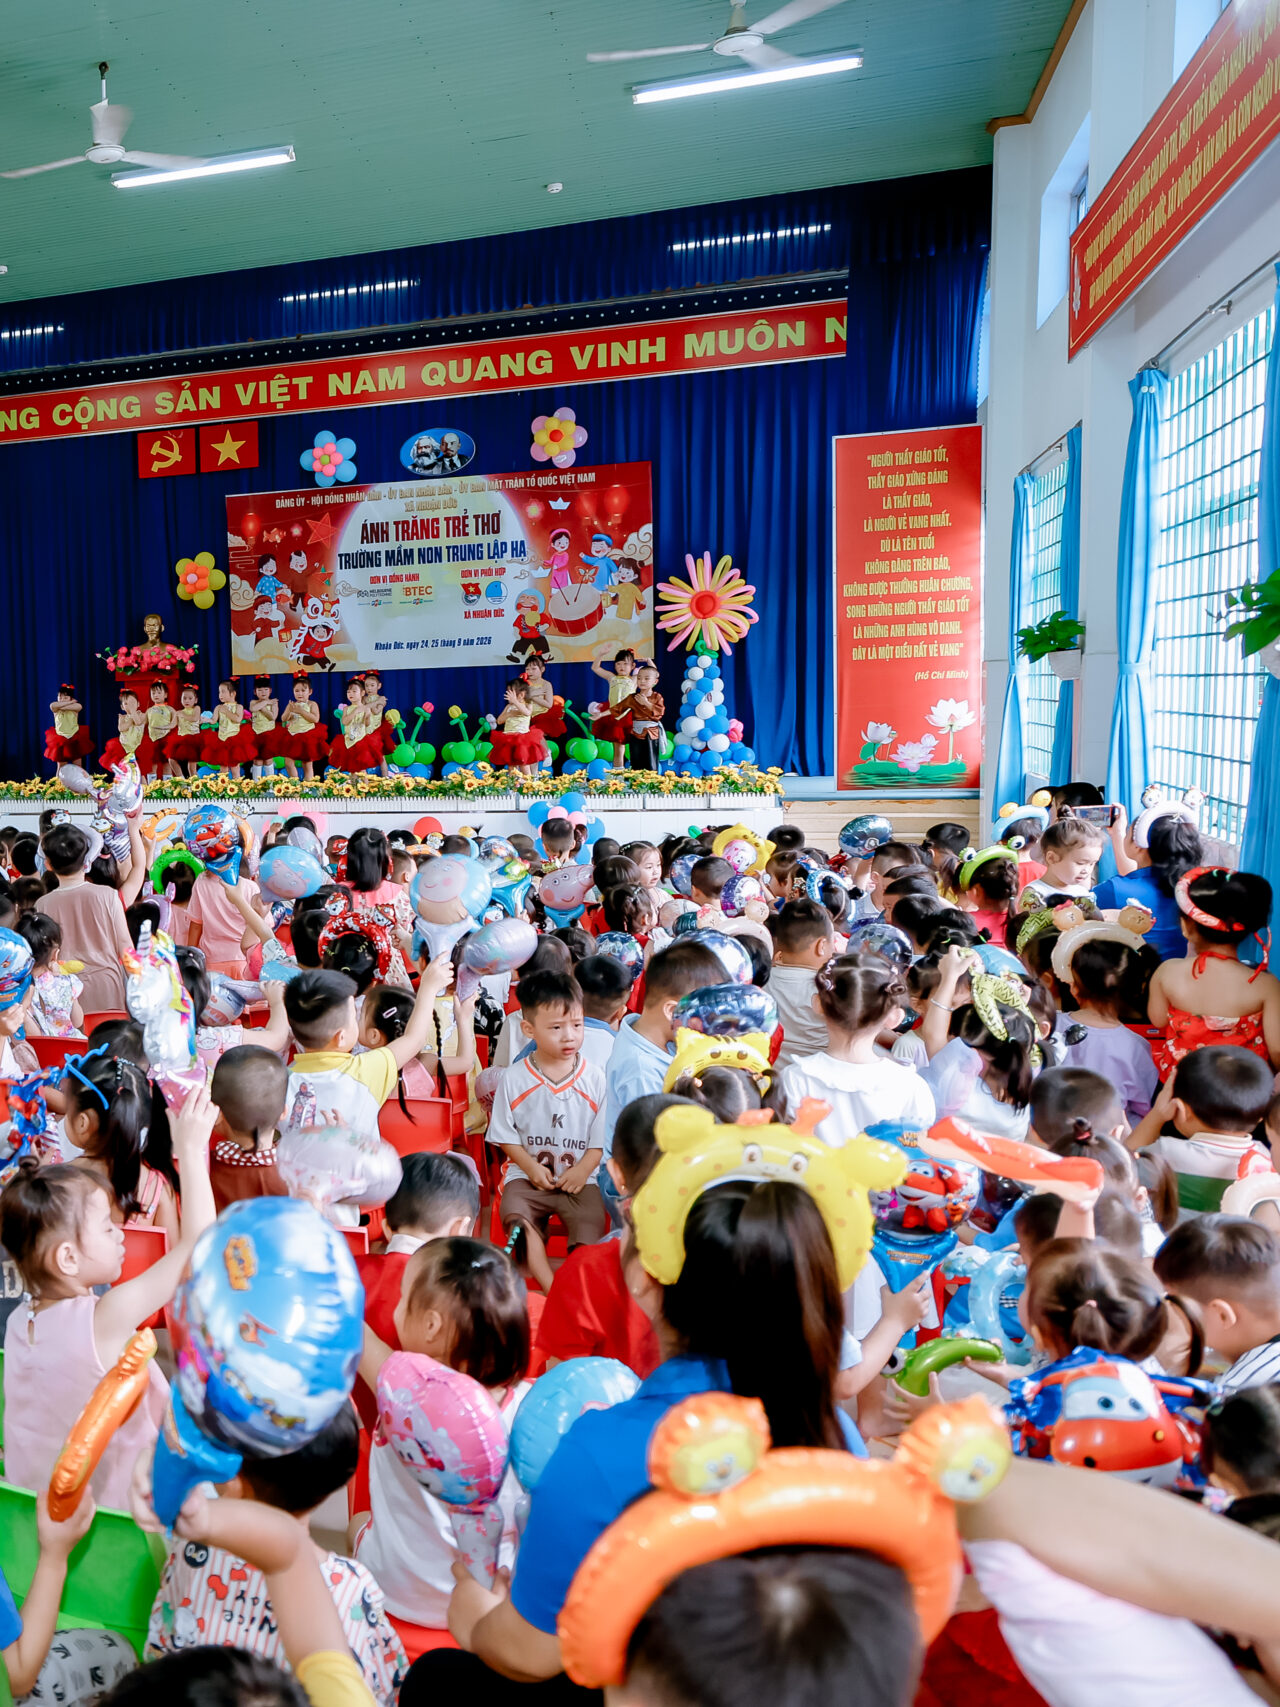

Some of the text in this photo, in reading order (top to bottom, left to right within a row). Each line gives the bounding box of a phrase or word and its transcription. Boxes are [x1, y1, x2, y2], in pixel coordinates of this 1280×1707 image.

[52, 396, 141, 431] CỘNG
[154, 380, 221, 416] SẢN
[234, 373, 313, 409] VIỆT
[328, 364, 406, 397] NAM
[420, 350, 553, 387] QUANG
[570, 336, 666, 371] VINH
[684, 319, 806, 360] MUÔN
[346, 492, 364, 502] NHÂN
[505, 478, 524, 490] TRẬN
[538, 474, 558, 487] QUỐC
[560, 472, 575, 486] VIỆT
[577, 473, 595, 483] NAM
[360, 509, 501, 544] ÁNH TRĂNG TRẺ THƠ
[338, 540, 526, 570] TRƯỜNG MẦM NON TRUNG LẬP HẠ
[405, 586, 432, 596] BTEC
[431, 639, 438, 647] 25
[551, 1114, 565, 1128] K
[527, 1136, 558, 1146] GOAL
